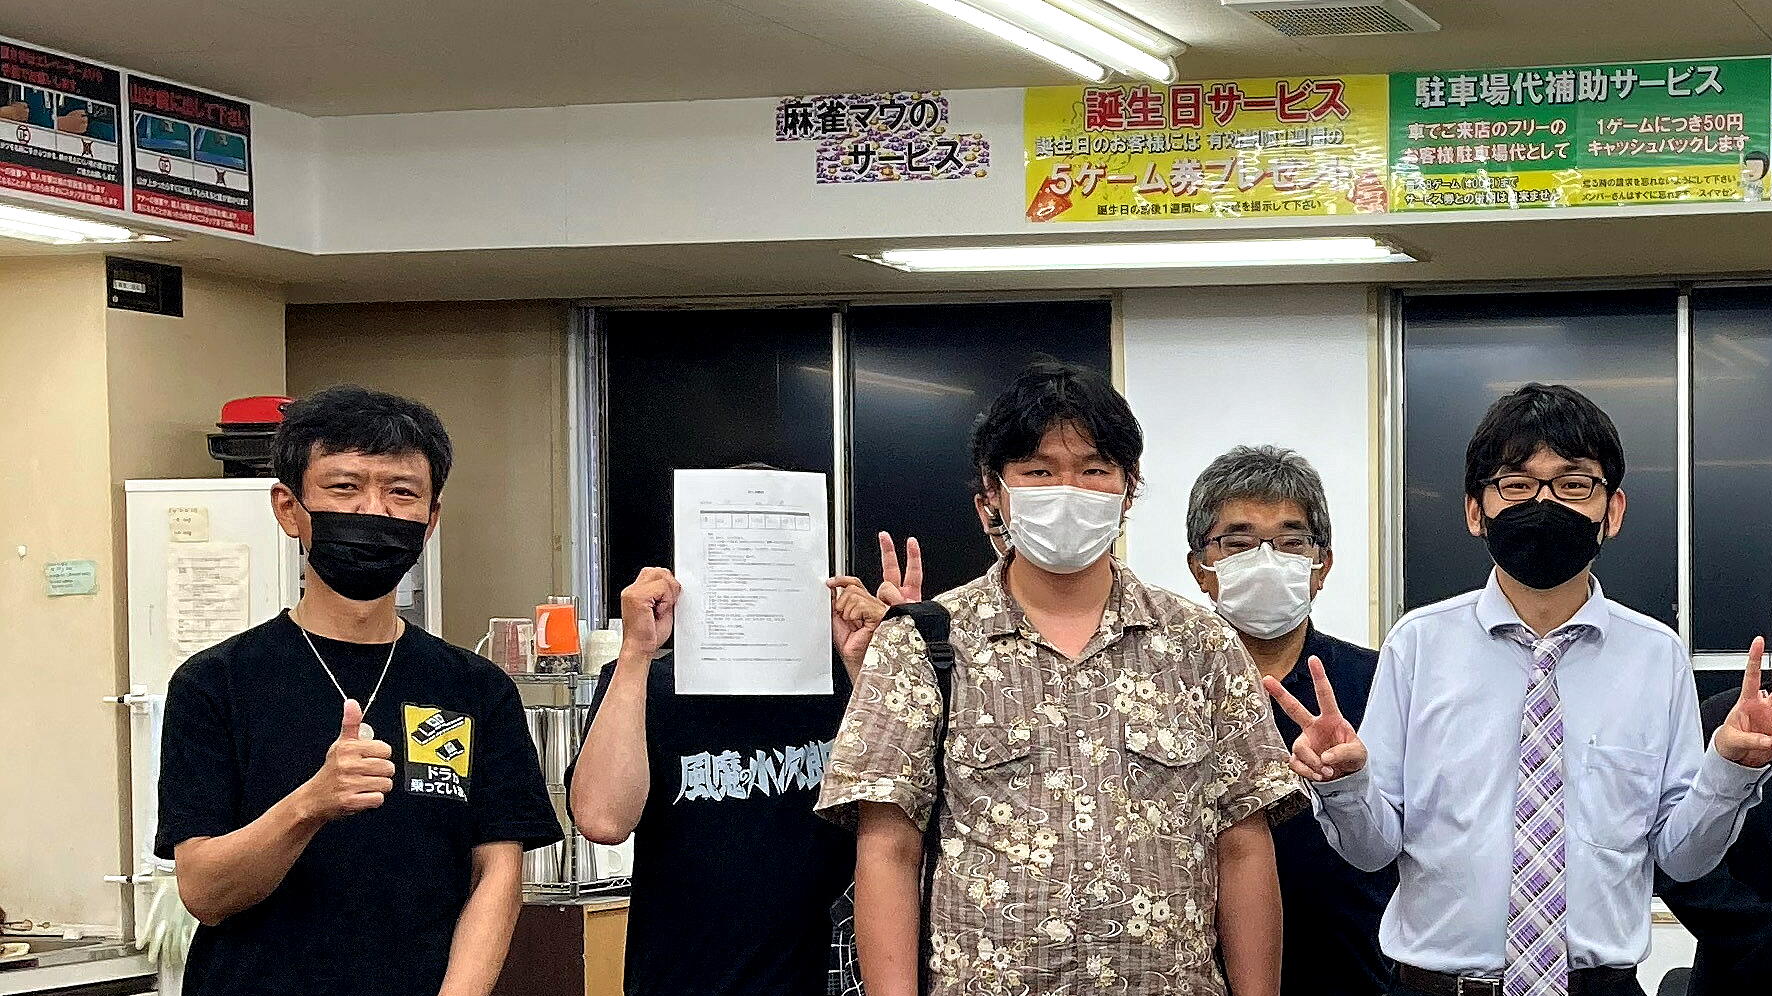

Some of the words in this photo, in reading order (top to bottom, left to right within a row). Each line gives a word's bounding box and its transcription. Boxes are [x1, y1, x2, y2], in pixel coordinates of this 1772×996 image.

[1415, 65, 1725, 109] 駐車場代補助サービス
[1083, 79, 1351, 132] 誕生日サービス
[1408, 119, 1568, 140] 車でご来店のフリーの
[1596, 113, 1744, 135] 1ゲームにつき50円
[1035, 132, 1201, 157] 誕生日のお客様には
[1403, 142, 1571, 164] お客様駐車場代として
[1588, 134, 1751, 156] キャッシュバックします
[848, 139, 964, 175] サービス
